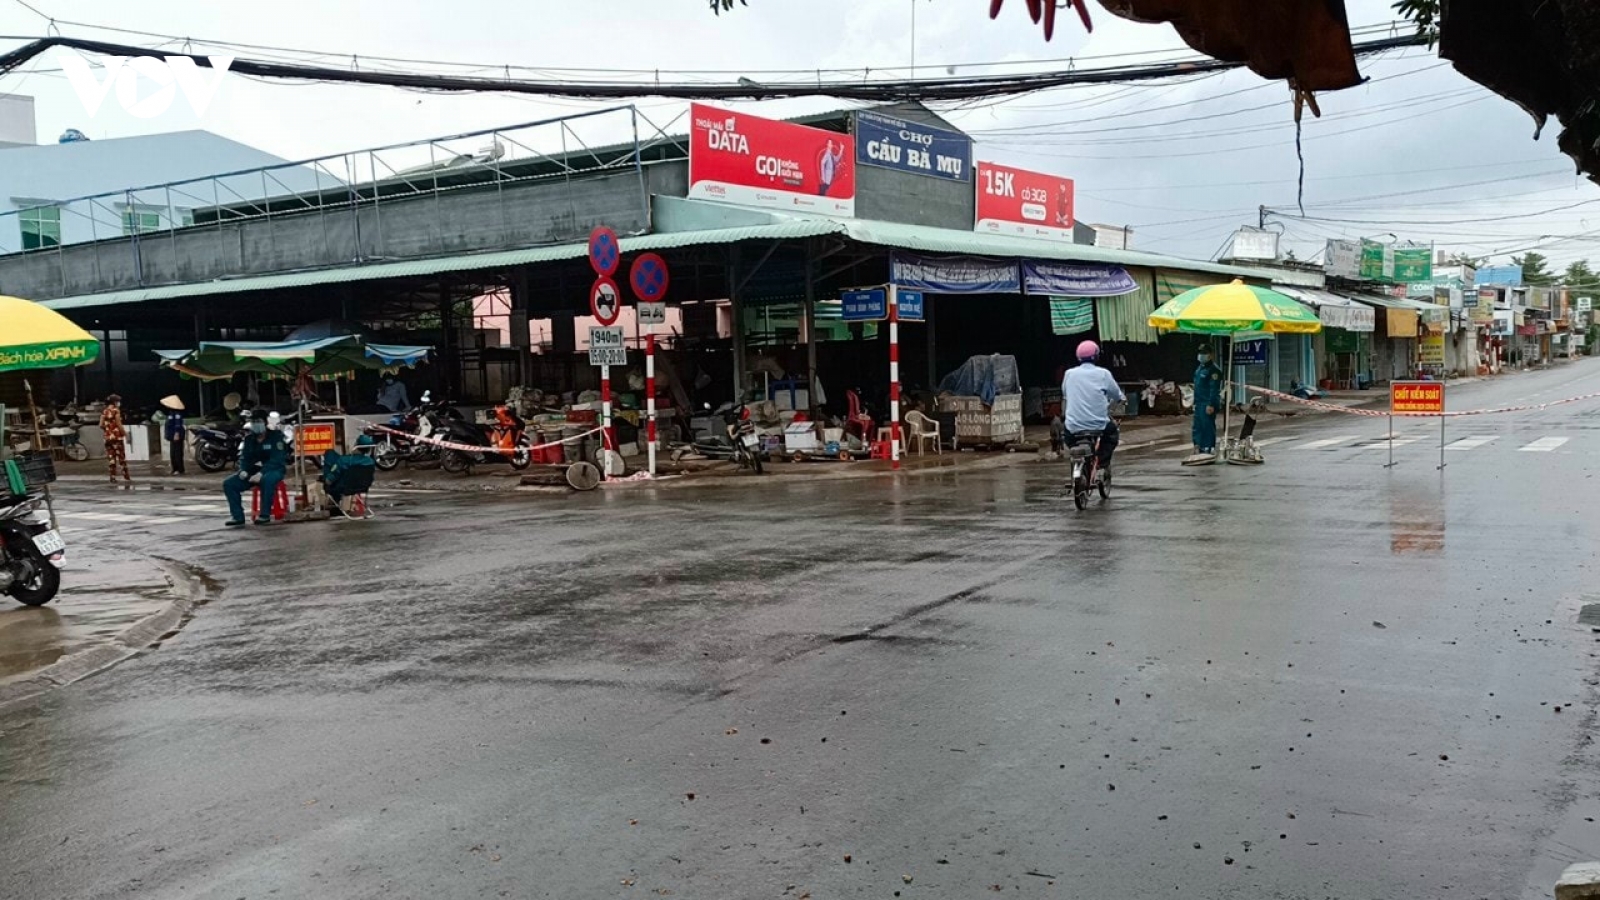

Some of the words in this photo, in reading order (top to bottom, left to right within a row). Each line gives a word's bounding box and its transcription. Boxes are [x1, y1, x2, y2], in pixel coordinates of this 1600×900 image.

[708, 129, 750, 155] DATA
[899, 129, 934, 149] CHỢ
[756, 154, 781, 182] GỌI
[866, 136, 902, 164] CẦU
[907, 147, 931, 170] BÀ
[937, 154, 962, 179] MỤ
[985, 169, 1015, 198] 15K
[44, 345, 86, 361] XANH
